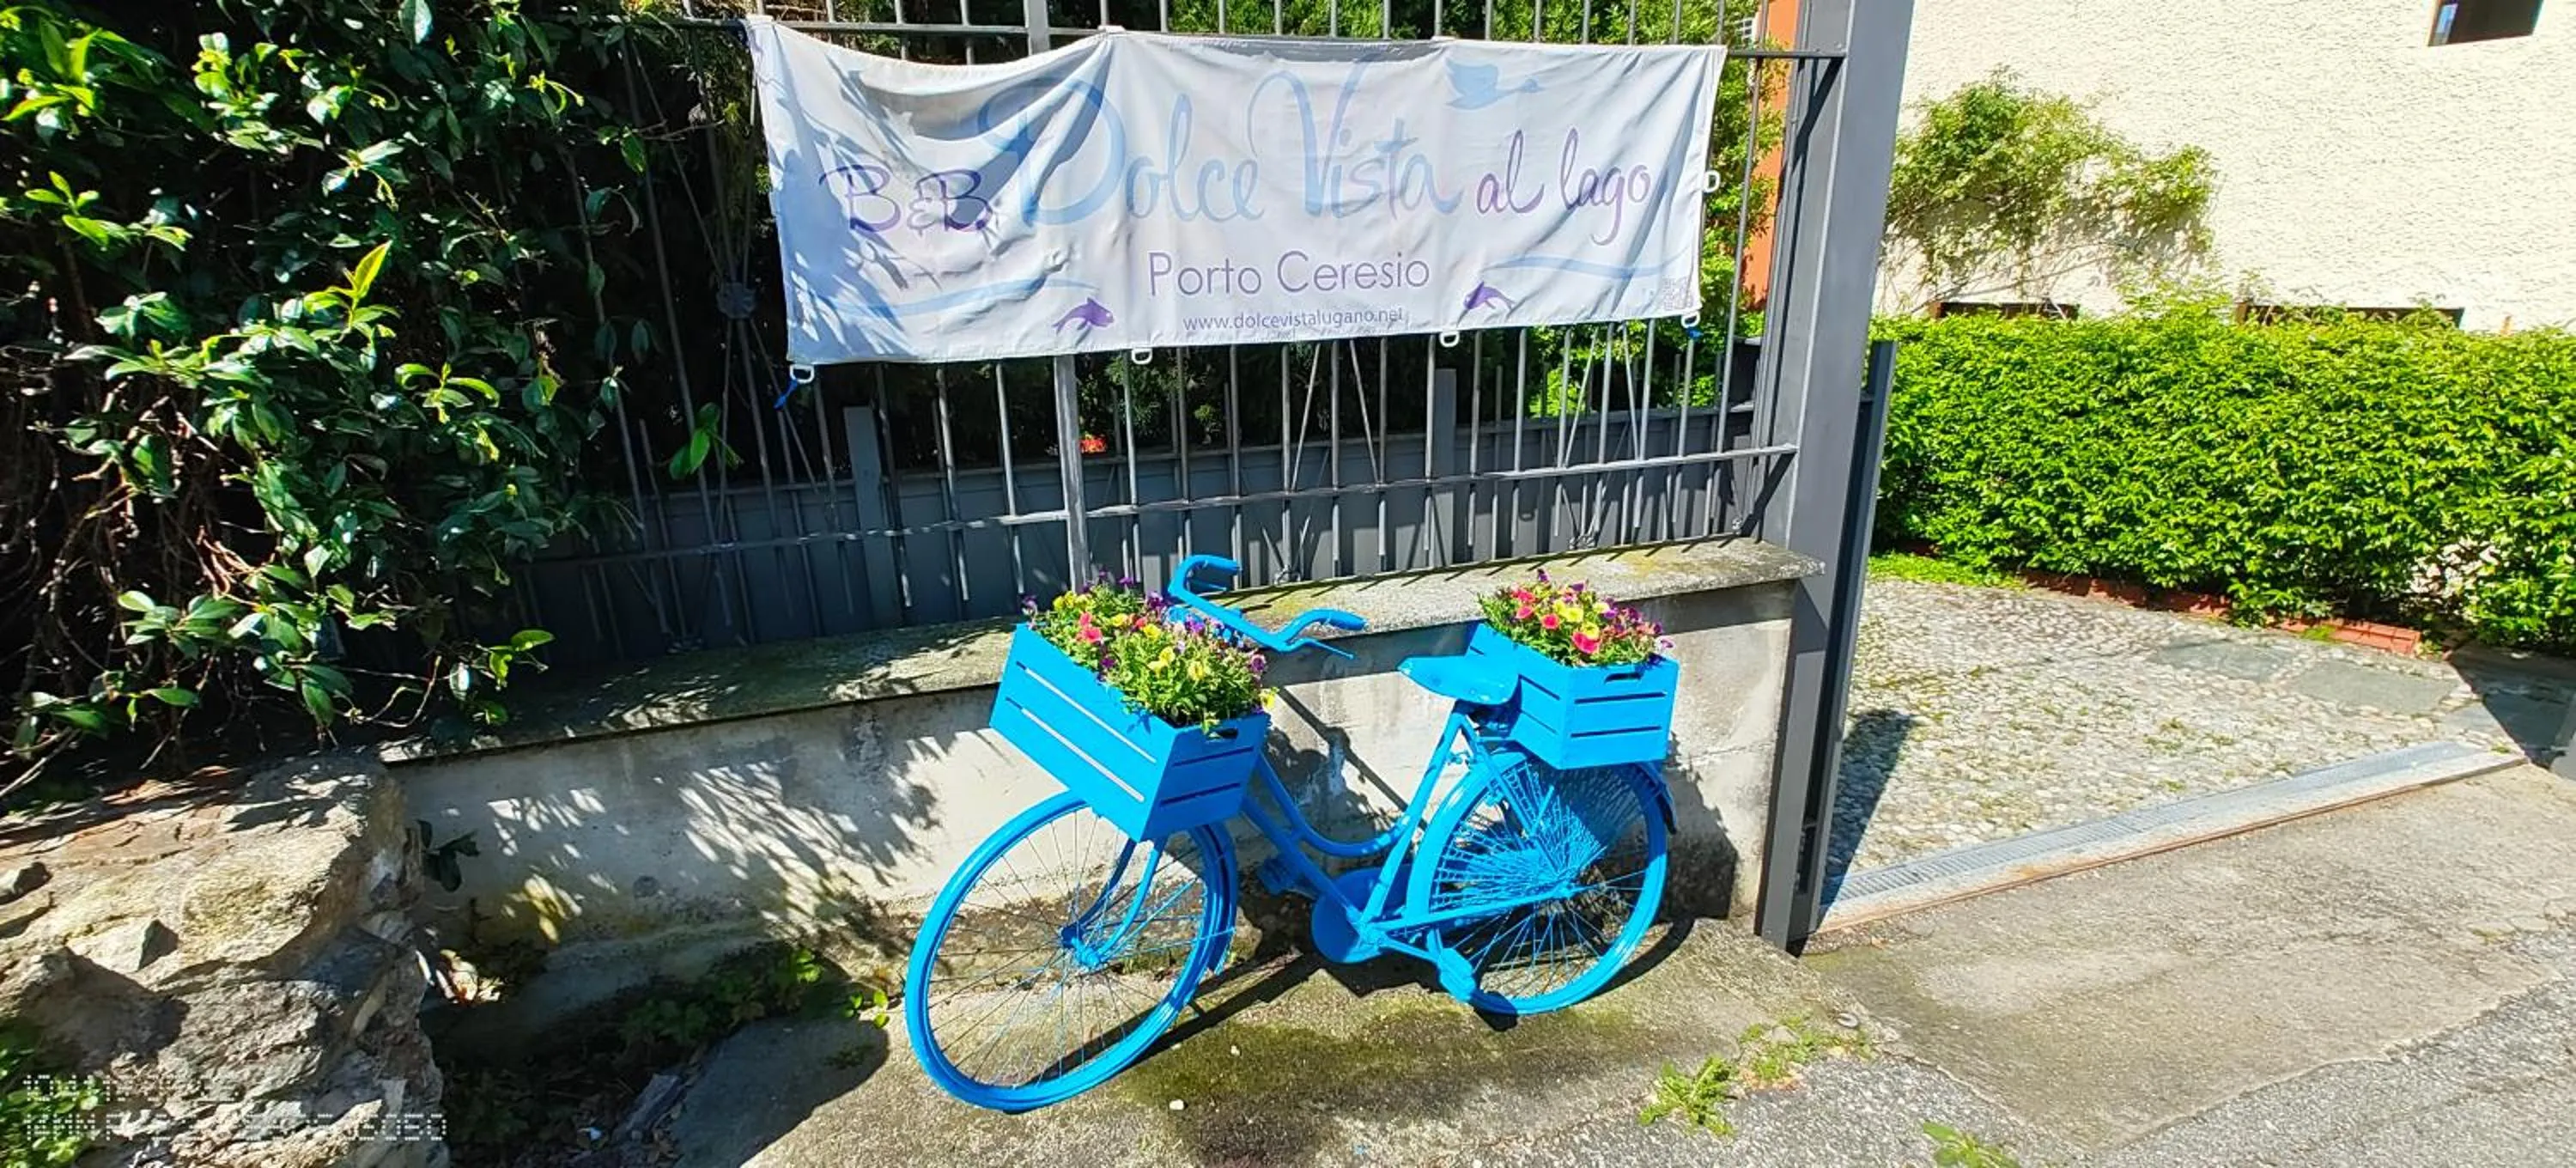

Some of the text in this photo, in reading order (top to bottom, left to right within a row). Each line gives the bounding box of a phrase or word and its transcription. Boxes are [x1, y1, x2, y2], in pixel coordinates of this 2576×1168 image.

[818, 53, 1653, 246] B&B Dolce Vista al lago
[1148, 251, 1431, 296] Porto Ceresio
